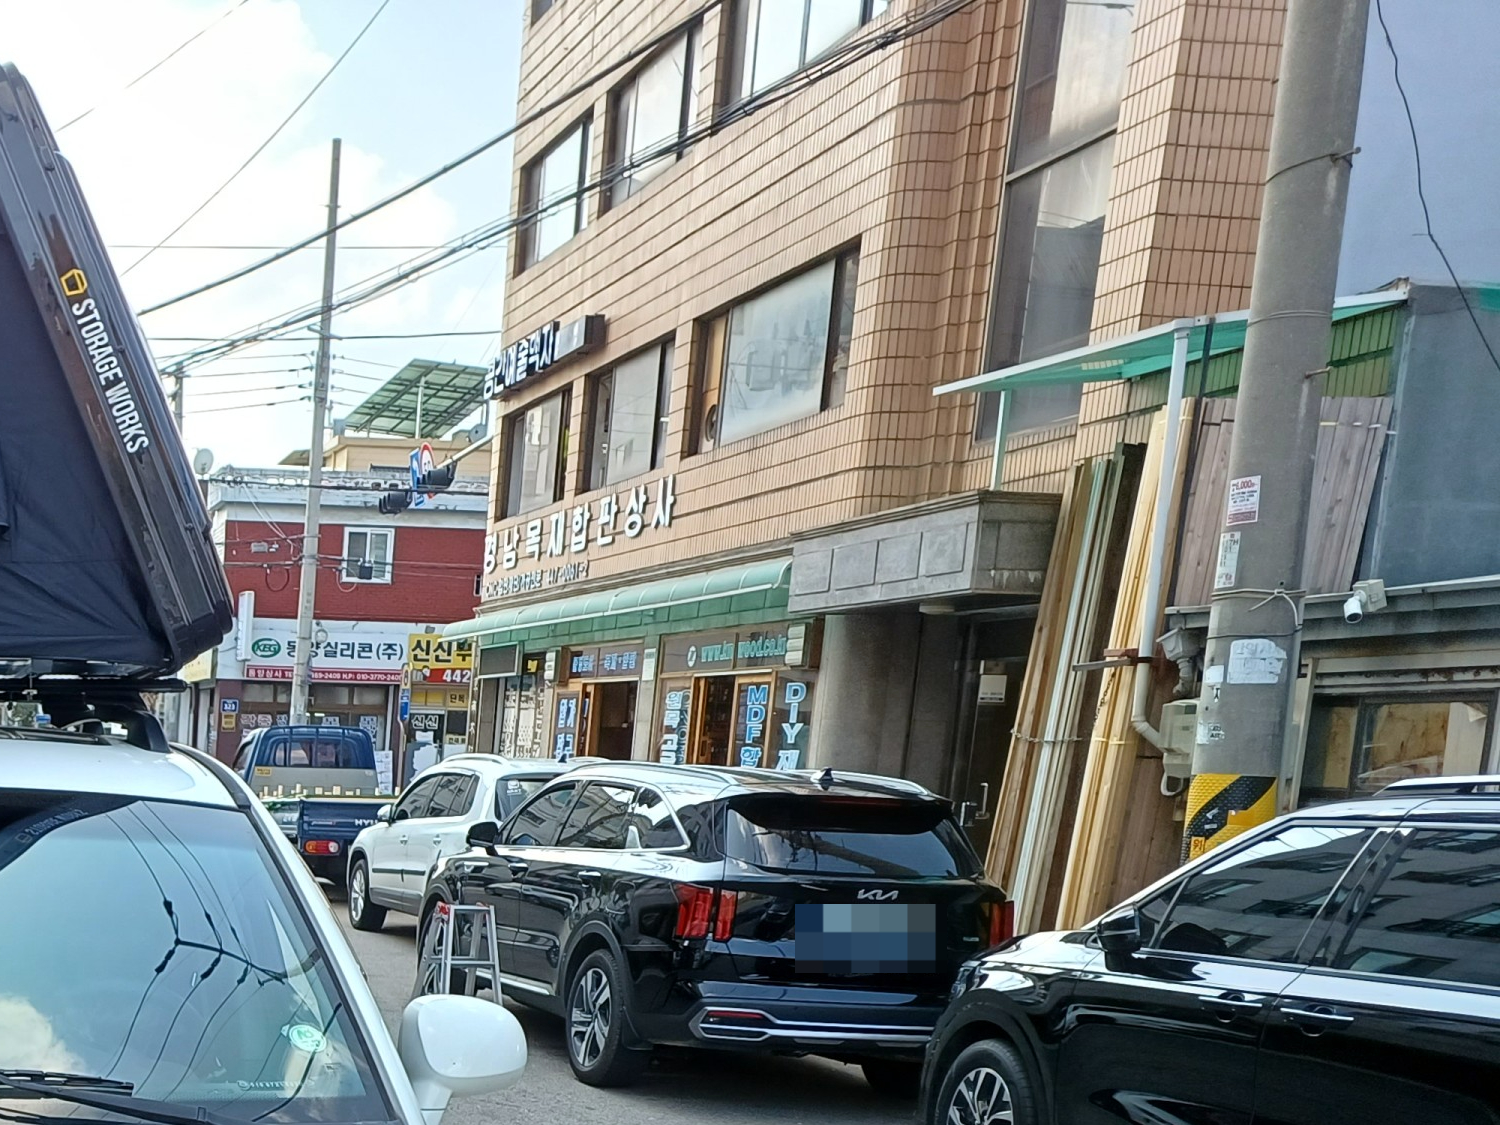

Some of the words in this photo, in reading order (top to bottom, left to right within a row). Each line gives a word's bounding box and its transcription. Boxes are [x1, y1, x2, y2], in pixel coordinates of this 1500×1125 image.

[71, 298, 124, 386] STORAGE
[104, 381, 149, 453] WORKS
[484, 474, 676, 575] 경남목재합판상사
[410, 714, 439, 730] 신신
[745, 685, 769, 744] MDF
[781, 682, 807, 744] DIY
